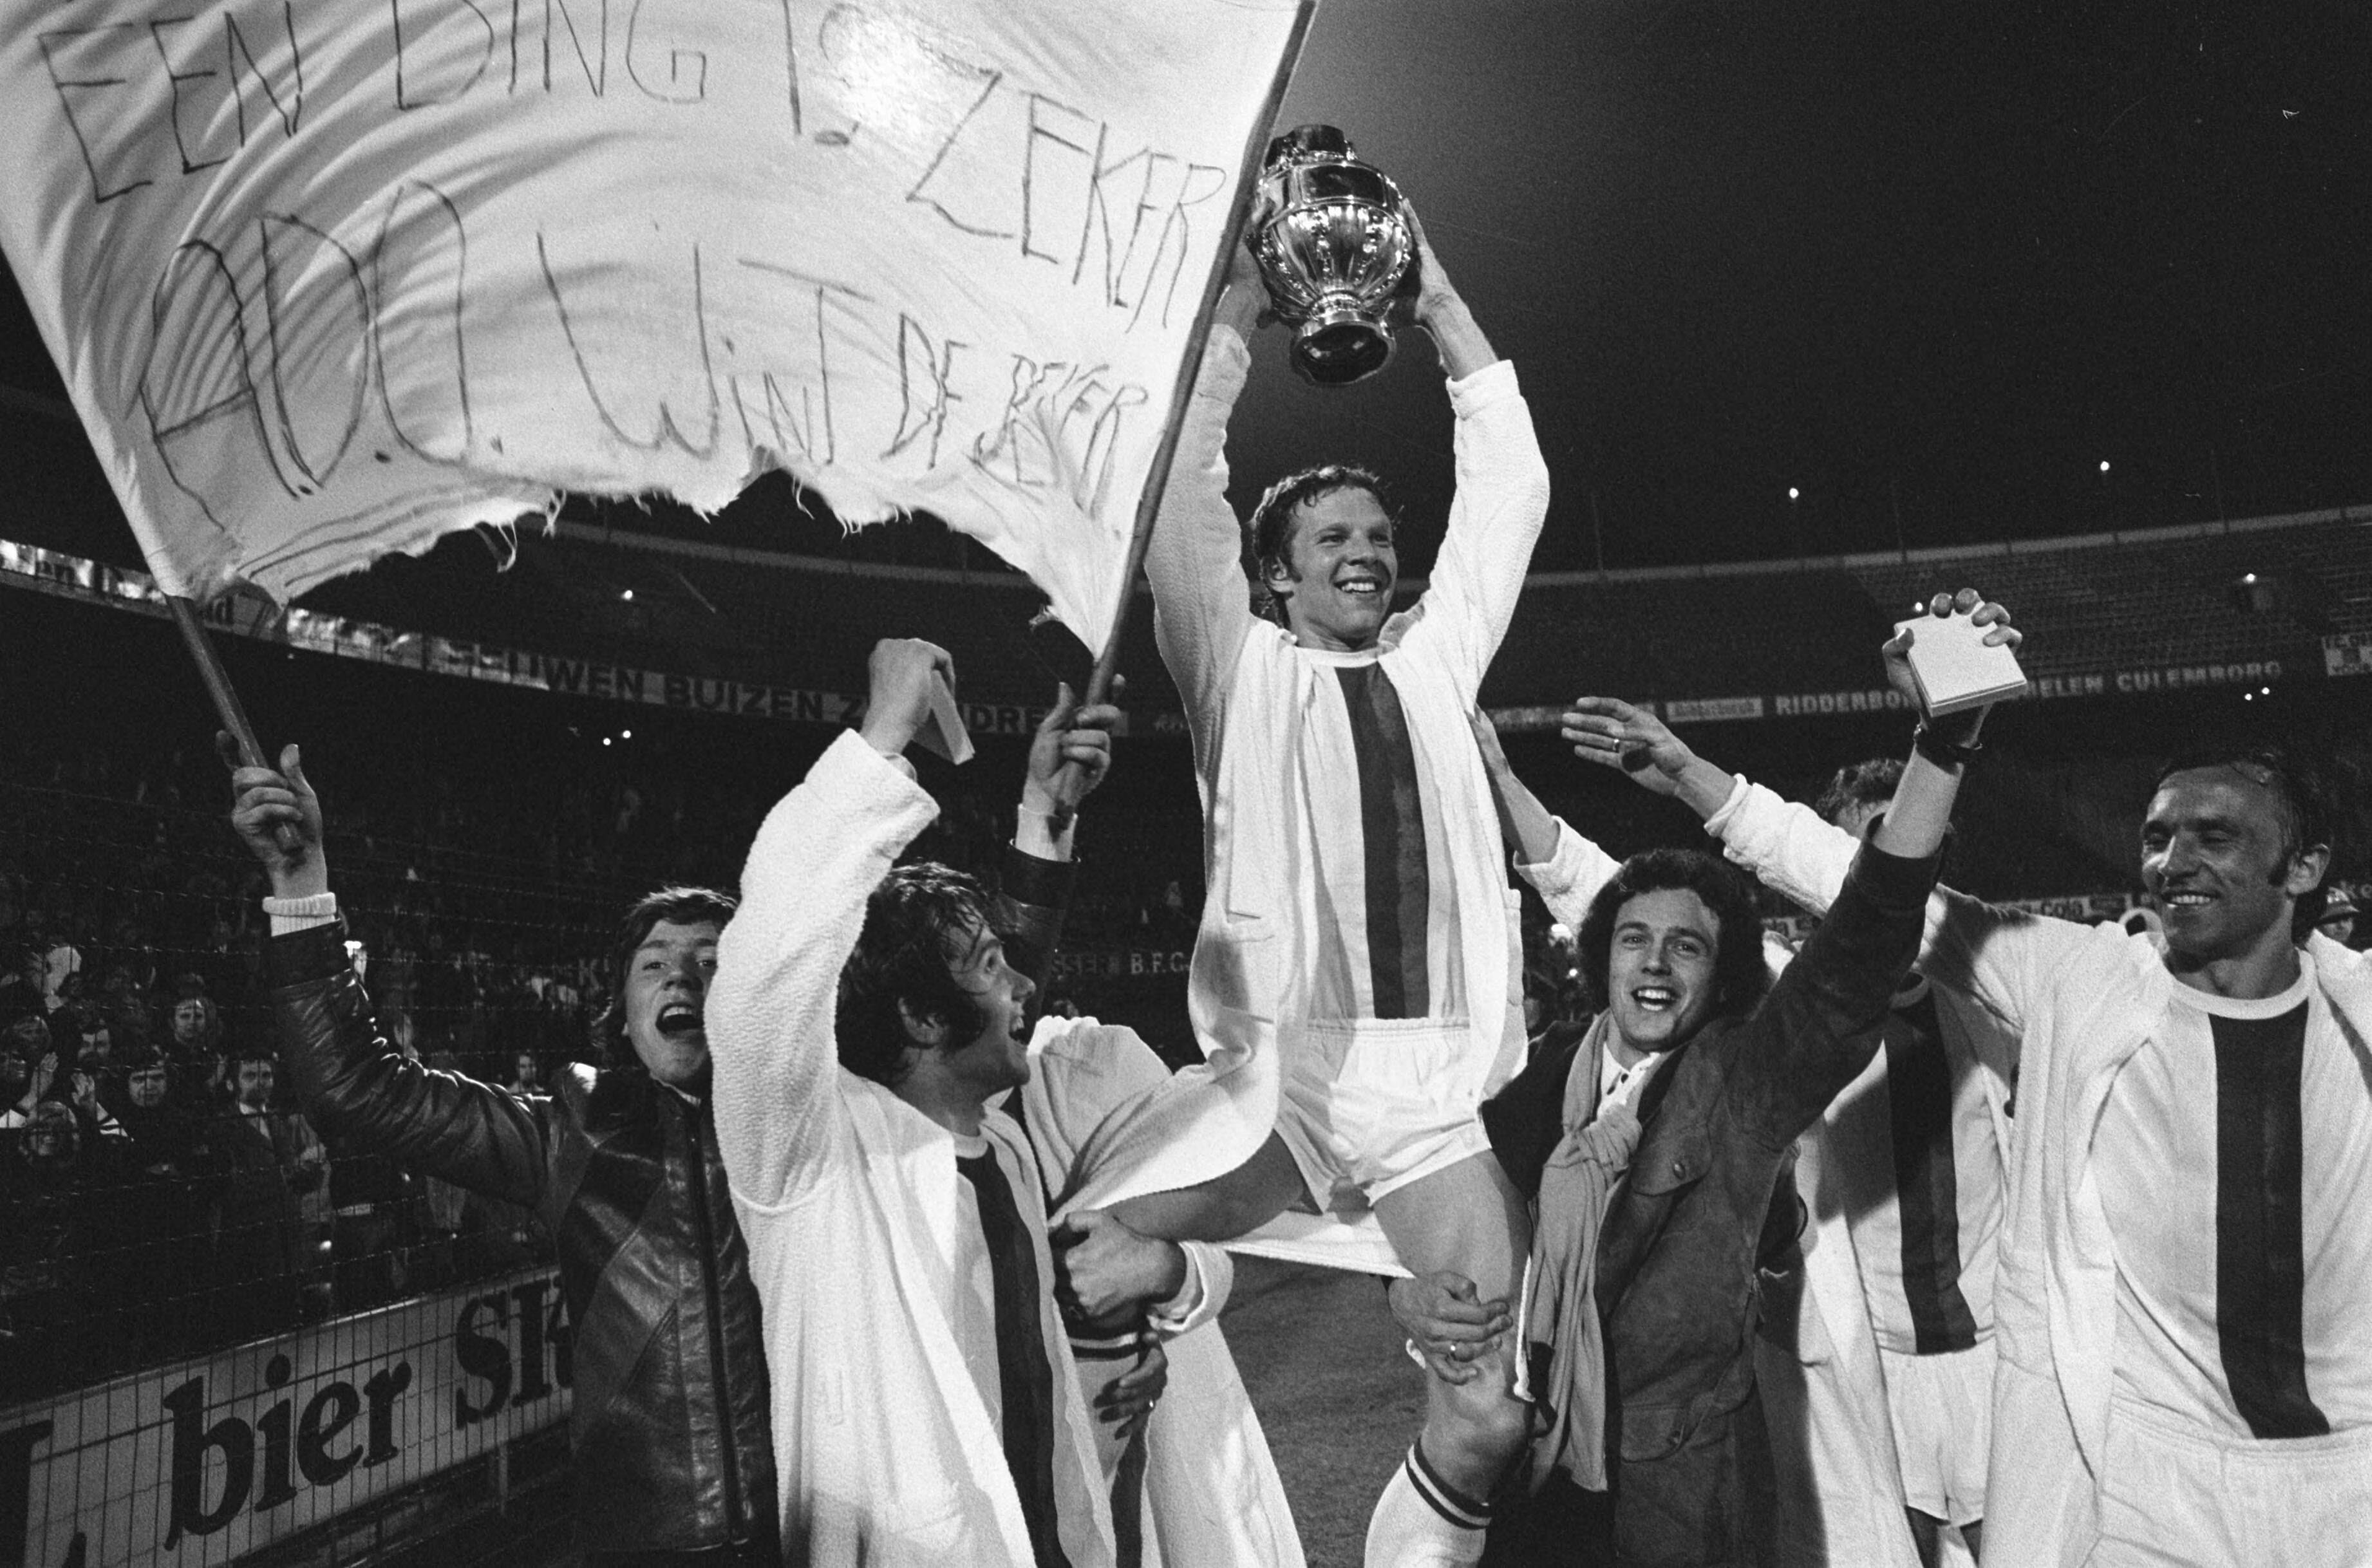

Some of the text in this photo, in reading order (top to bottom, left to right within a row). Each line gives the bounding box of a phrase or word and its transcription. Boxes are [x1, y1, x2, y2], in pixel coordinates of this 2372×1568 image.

[38, 0, 303, 203] EEN
[393, 0, 706, 109] DING
[907, 44, 1227, 333] ZEKER
[879, 312, 968, 471] DE
[664, 674, 823, 722] BUIZEN
[162, 1353, 413, 1552] bier
